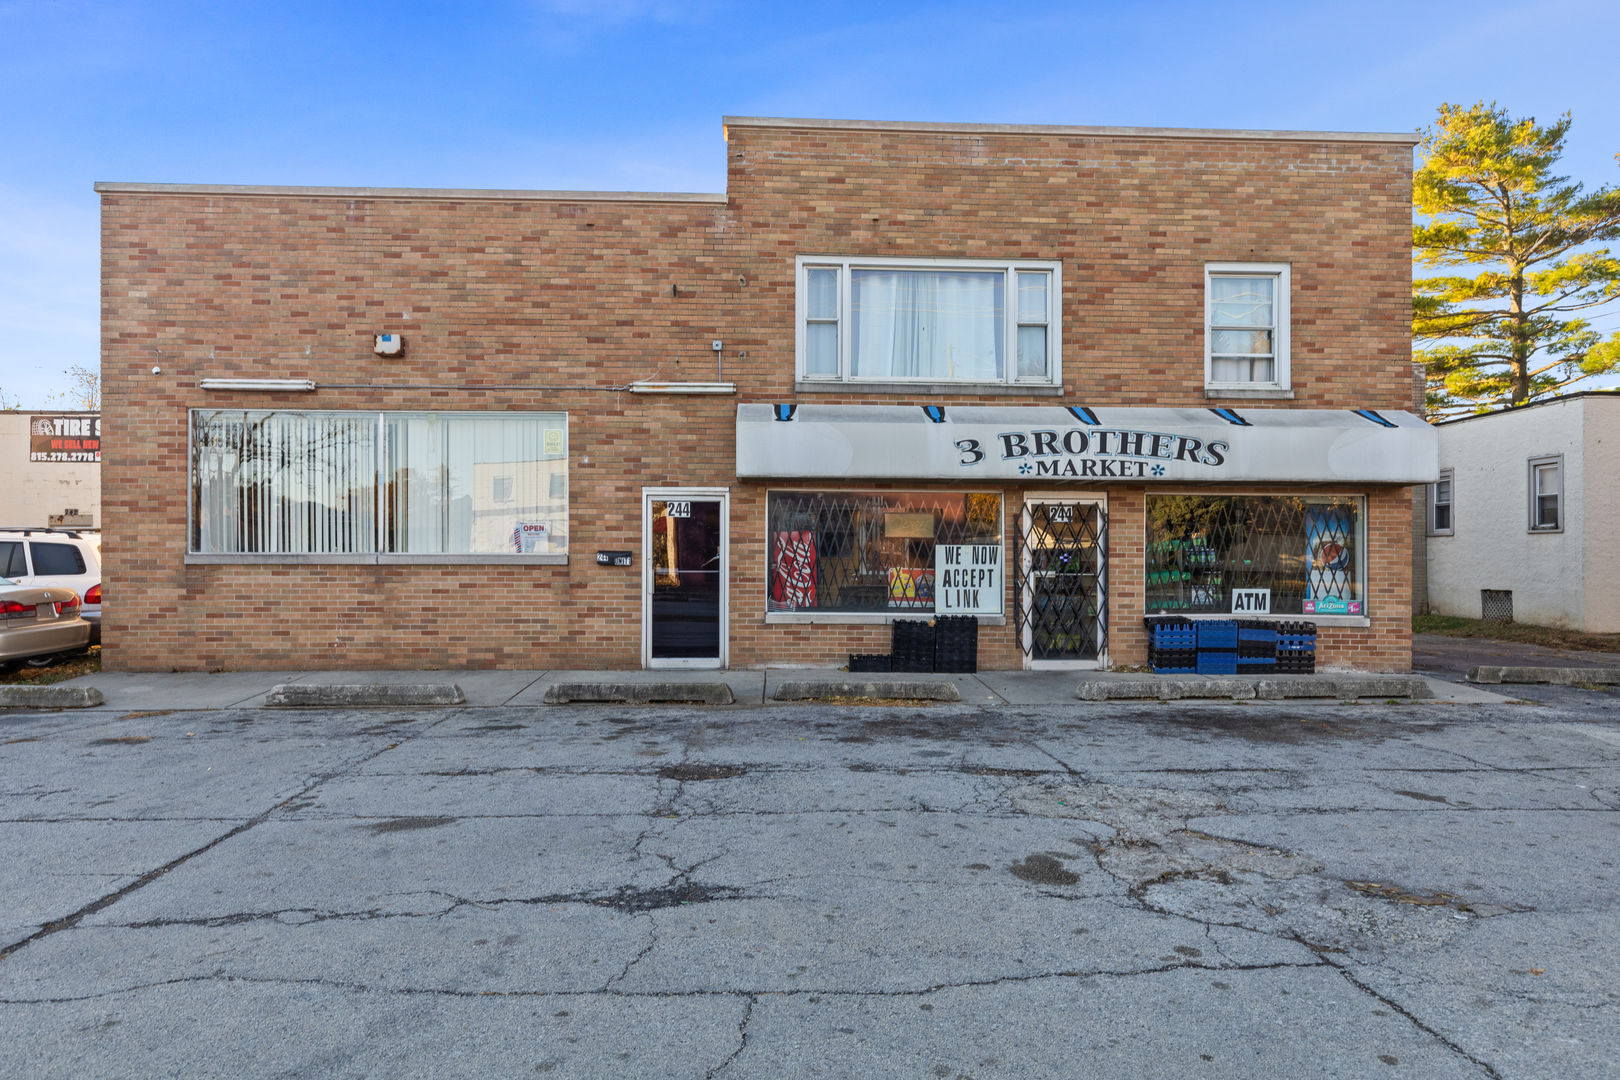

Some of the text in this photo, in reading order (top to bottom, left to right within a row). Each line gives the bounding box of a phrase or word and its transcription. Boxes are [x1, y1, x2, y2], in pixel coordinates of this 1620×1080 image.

[53, 418, 91, 436] TIRE
[31, 452, 94, 461] 815.278.2778
[955, 429, 1230, 467] 3 BROTHERS
[1035, 459, 1149, 478] MARKET
[668, 503, 690, 516] 244
[1050, 507, 1073, 521] 244
[945, 546, 999, 565] WE NOW
[942, 569, 994, 588] ACCEPT
[945, 589, 980, 608] LINK
[1234, 592, 1267, 611] ATM
